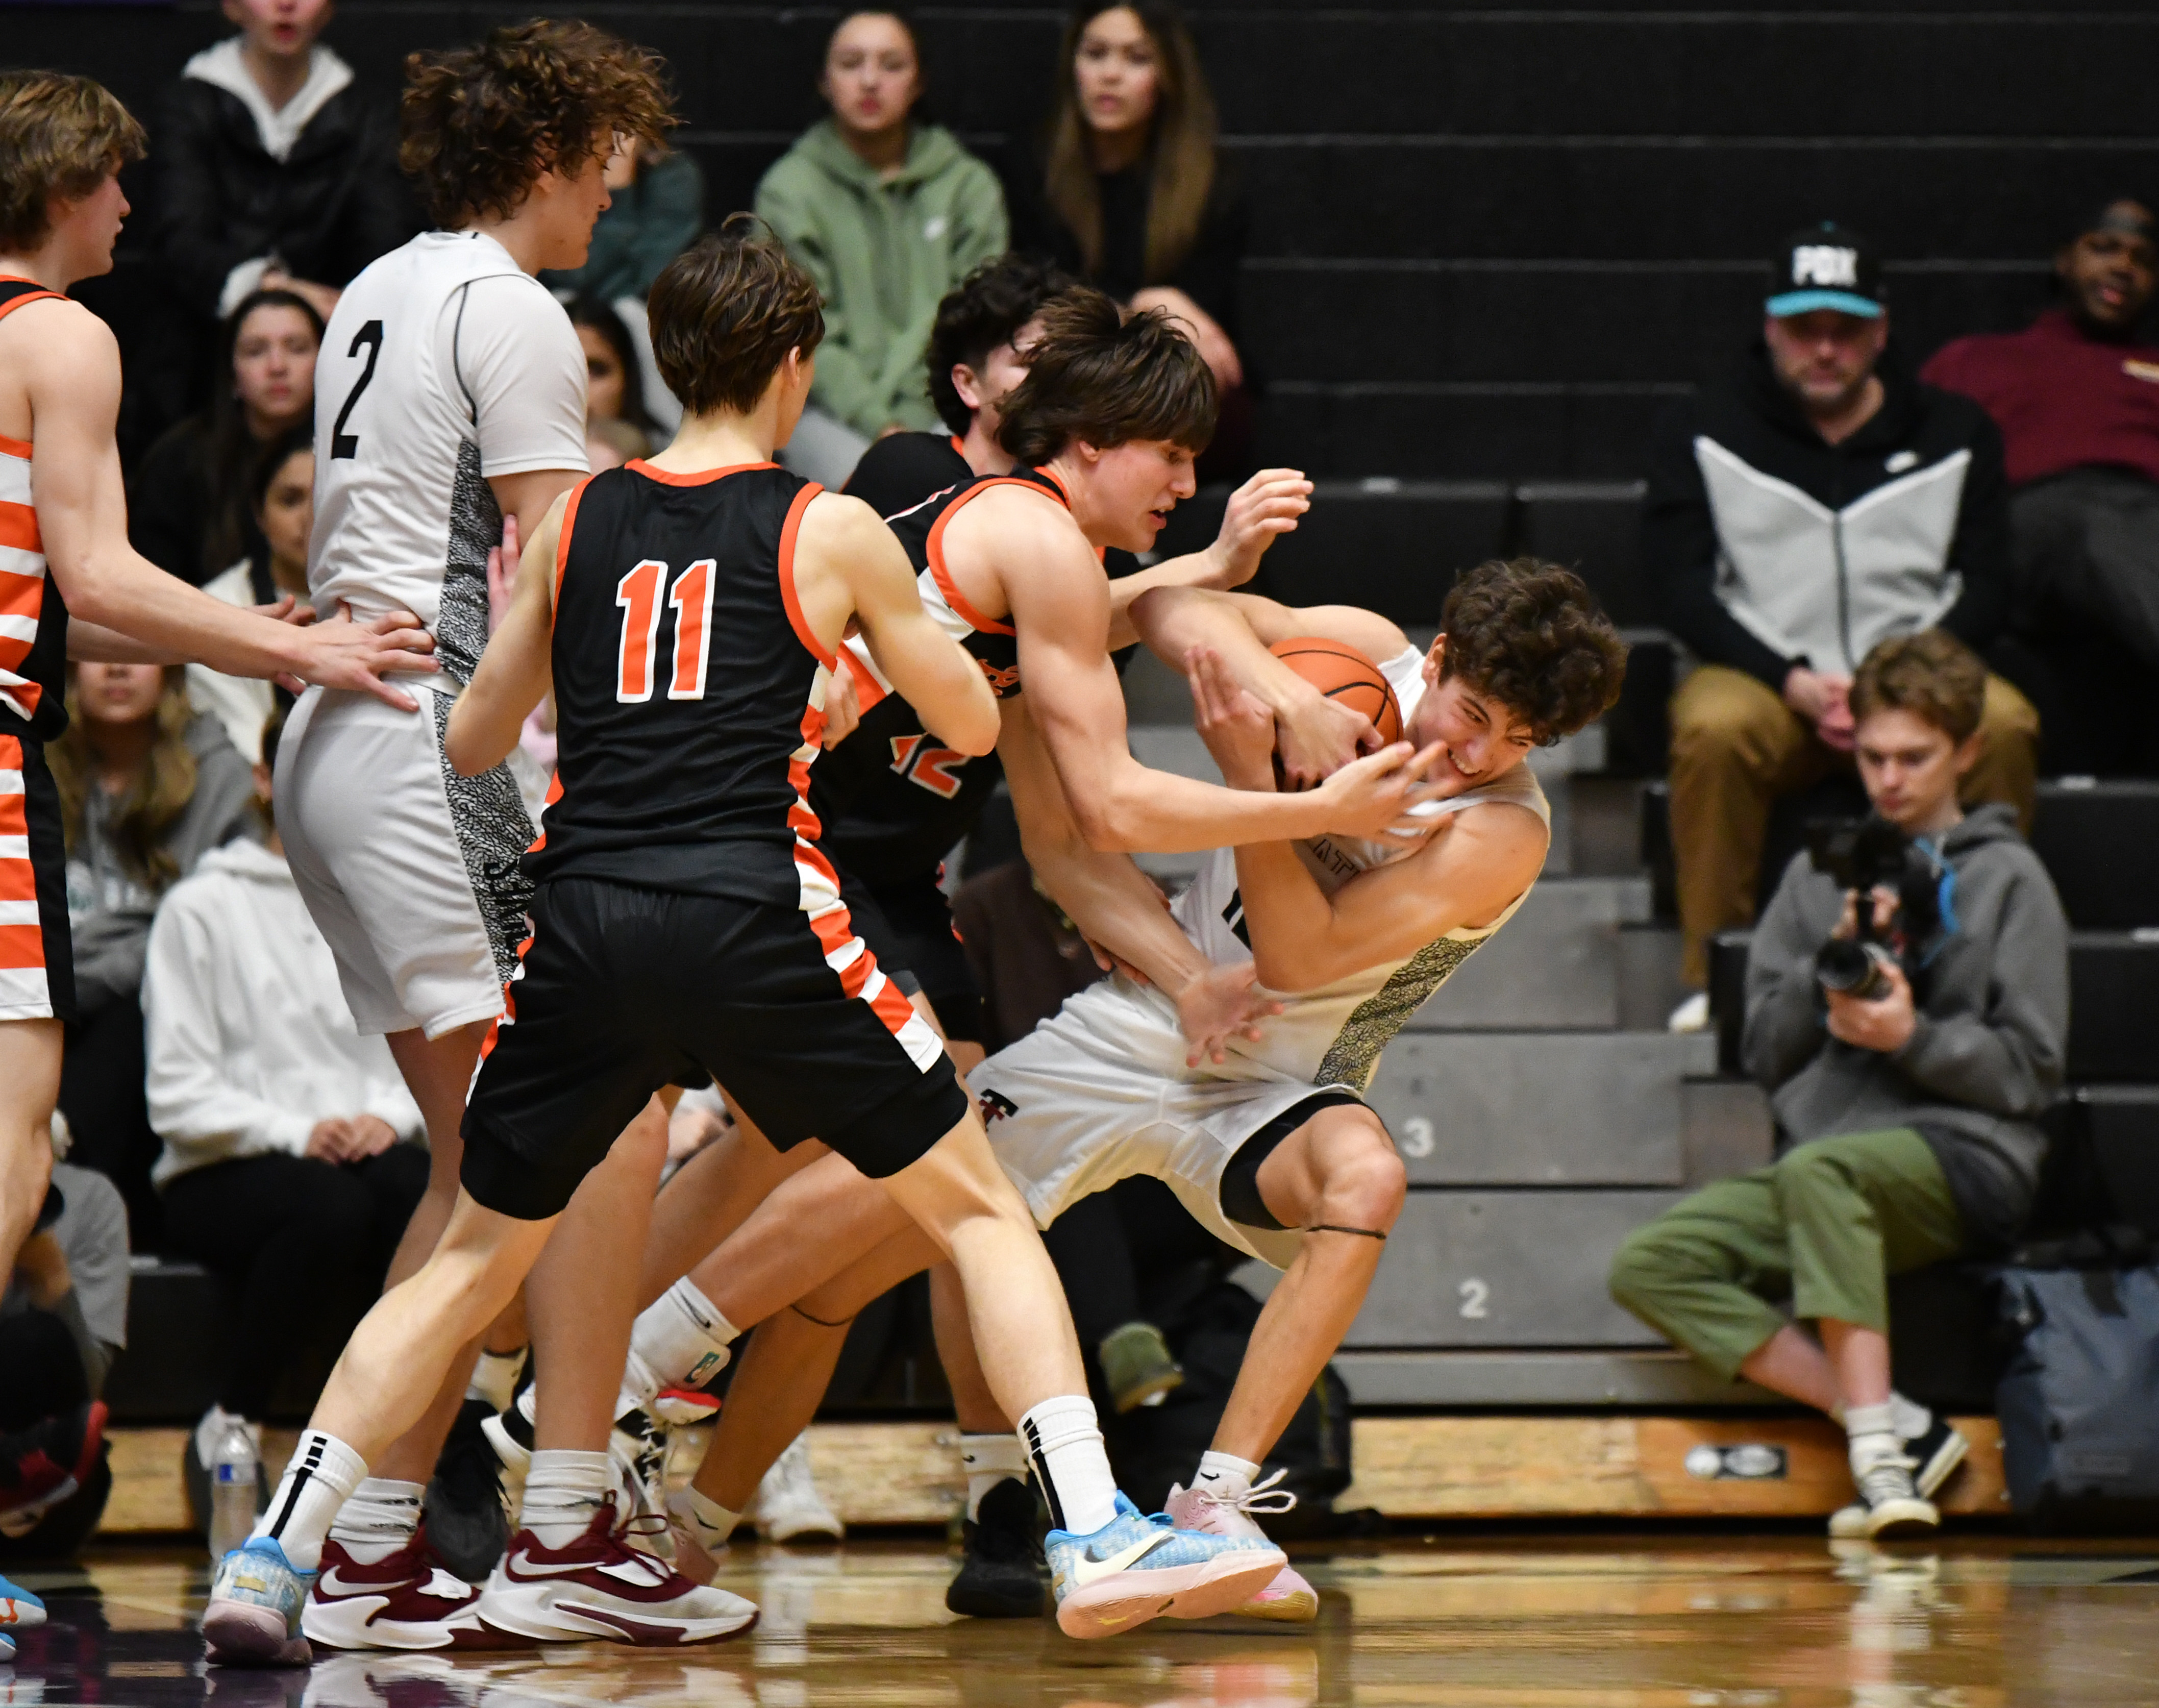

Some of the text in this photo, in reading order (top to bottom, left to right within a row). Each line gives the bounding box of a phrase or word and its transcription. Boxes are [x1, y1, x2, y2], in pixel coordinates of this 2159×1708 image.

[331, 319, 383, 460] 2
[615, 558, 717, 704] 11
[1402, 1116, 1435, 1158] 3
[1459, 1278, 1489, 1319] 2
